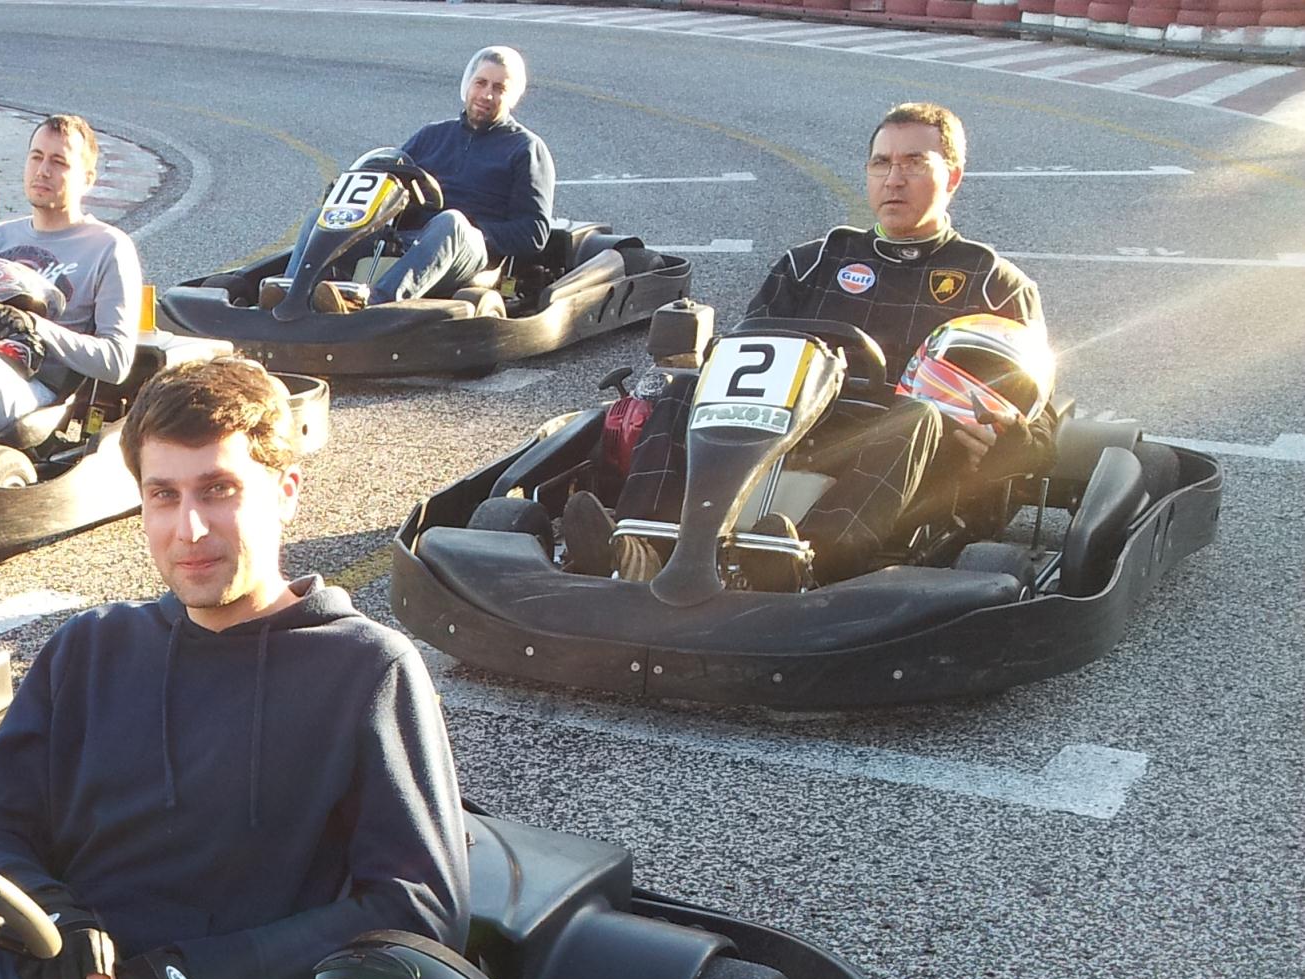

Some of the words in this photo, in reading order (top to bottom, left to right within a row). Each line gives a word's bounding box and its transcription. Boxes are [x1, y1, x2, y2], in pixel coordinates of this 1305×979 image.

[335, 174, 378, 205] 12
[841, 271, 872, 286] Gulf
[725, 343, 776, 398] 2
